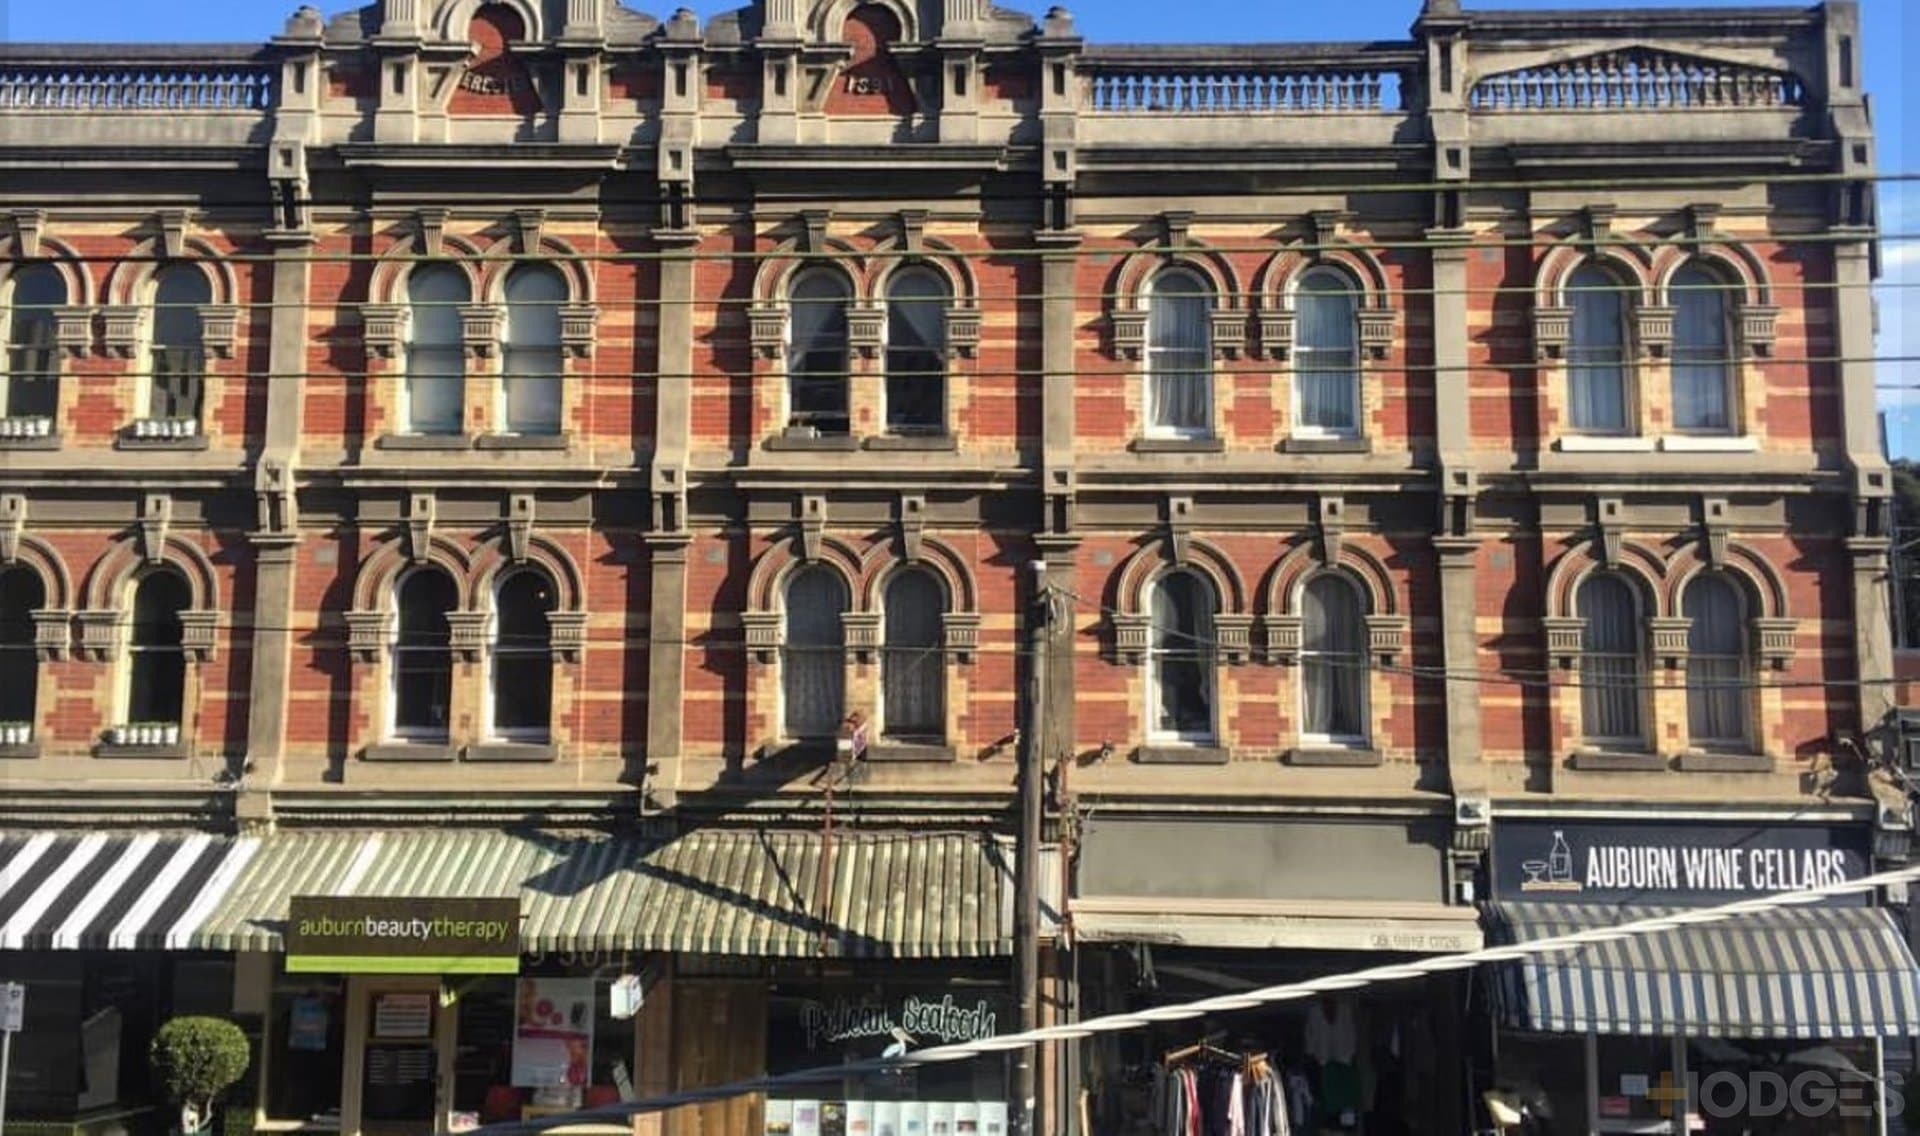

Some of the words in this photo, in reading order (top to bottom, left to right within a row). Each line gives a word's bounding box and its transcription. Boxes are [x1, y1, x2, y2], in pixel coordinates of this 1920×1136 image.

[1586, 846, 1678, 889] AUBURN
[1683, 847, 1744, 890] WINE
[1750, 849, 1845, 890] CELLARS
